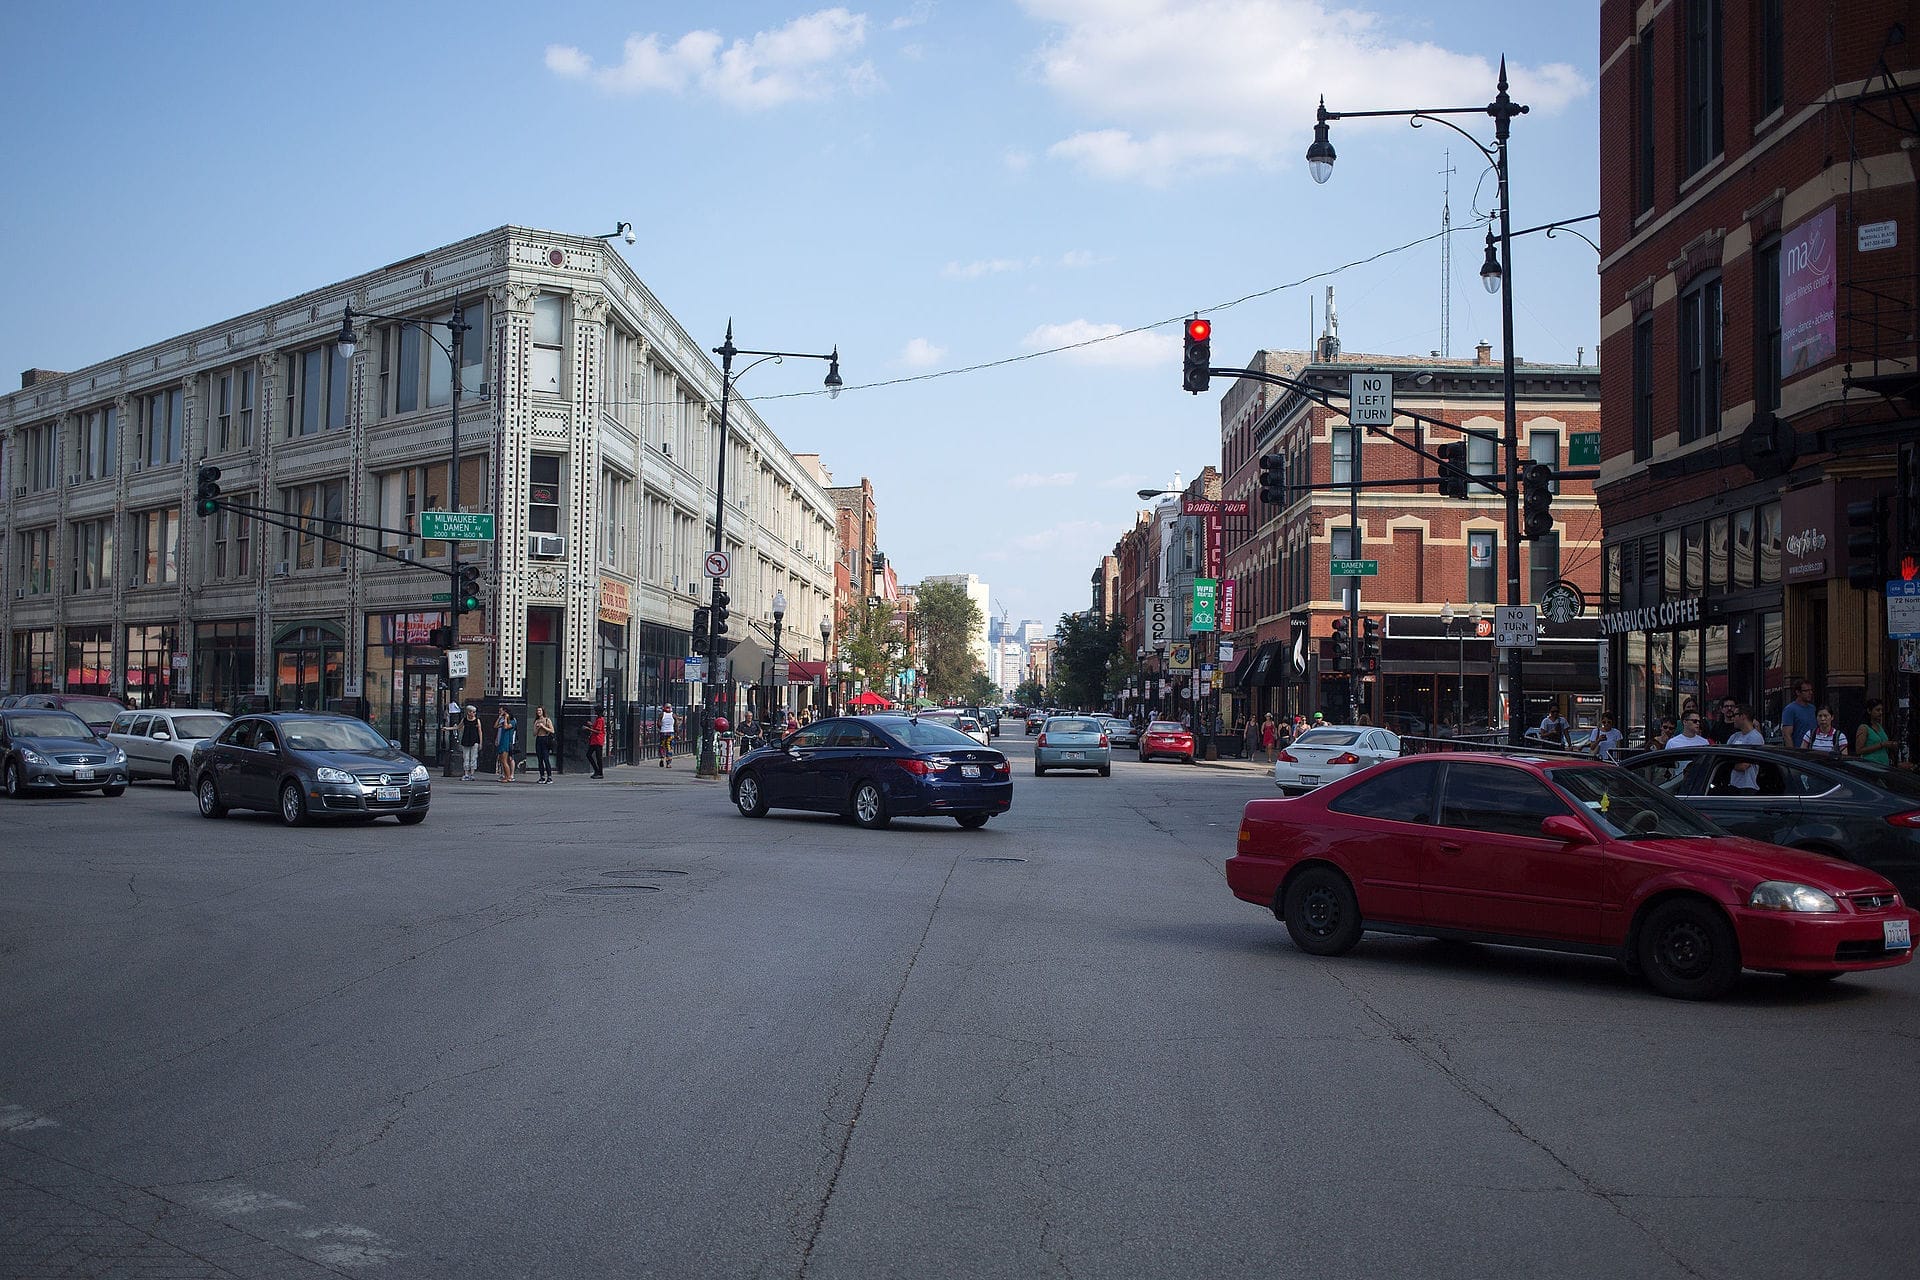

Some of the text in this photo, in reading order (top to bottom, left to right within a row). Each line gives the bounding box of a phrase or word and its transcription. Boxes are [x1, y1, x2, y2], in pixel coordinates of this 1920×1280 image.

[1798, 282, 1812, 300] fitness
[1813, 274, 1830, 290] centre
[1815, 310, 1834, 326] achieve
[1364, 380, 1382, 390] NO
[1358, 396, 1386, 405] LEFT
[1357, 410, 1386, 419] TURN
[1187, 503, 1220, 513] DOUBLE
[435, 515, 478, 523] MILWAUKEE
[1508, 611, 1524, 619] NO
[1600, 597, 1700, 635] STARBUCKS COFFEE
[1478, 624, 1489, 633] BY
[1504, 622, 1528, 630] TURN
